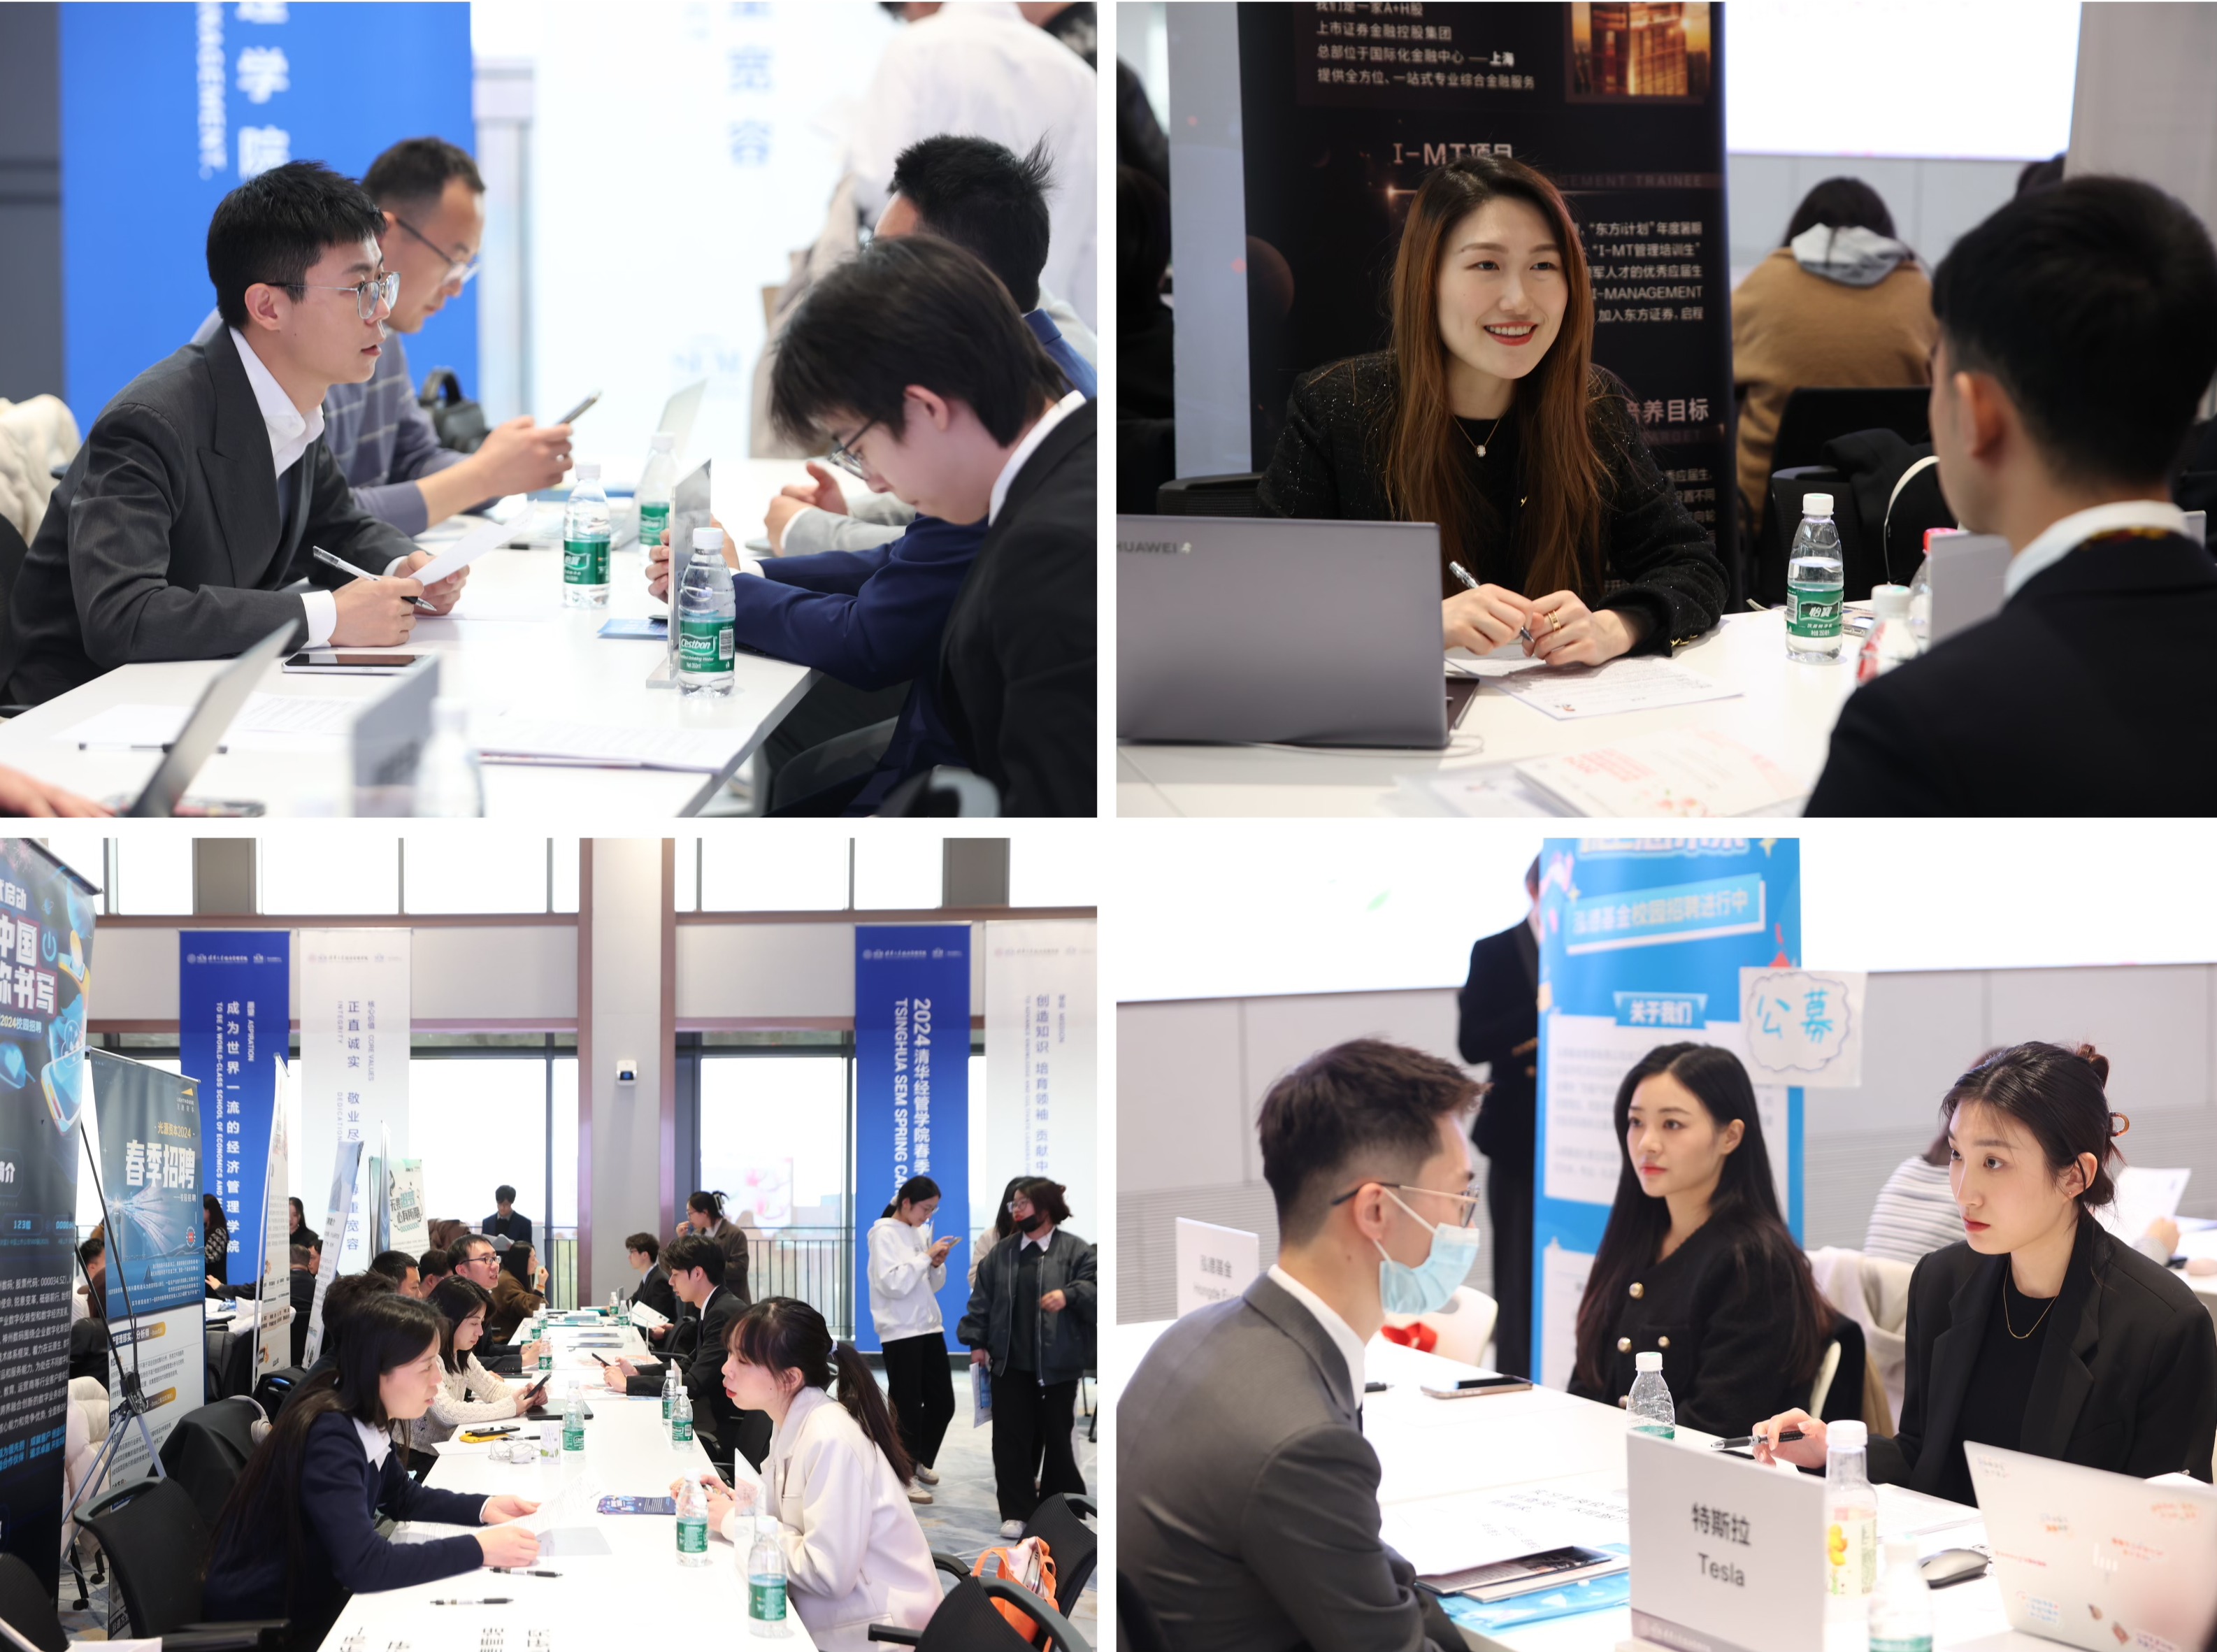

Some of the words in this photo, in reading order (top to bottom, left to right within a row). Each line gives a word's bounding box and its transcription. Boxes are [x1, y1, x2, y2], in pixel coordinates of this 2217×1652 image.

[1316, 21, 1453, 41] 上市证券金融控股集团
[1317, 45, 1465, 65] 总部位于国际化金融中心
[1318, 68, 1535, 90] 提供全方位、一站式专业综合金融服务
[1636, 175, 1702, 186] TRAINEE
[681, 638, 711, 649] Cestbon
[216, 1002, 224, 1012] TO
[216, 1014, 224, 1023] BE
[914, 998, 931, 1046] 2024
[1036, 994, 1049, 1054] 创造知识
[1629, 1000, 1693, 1026] 关于我们
[1758, 990, 1833, 1044] 公募
[347, 1001, 359, 1068] 正直诚实
[894, 998, 908, 1072] TSINGHUA
[894, 1075, 908, 1105] SEM
[1036, 1062, 1049, 1121] 培育领袖
[216, 1121, 224, 1131] OF
[226, 1001, 240, 1253] 成为世界一流的经济管理学院
[347, 1092, 359, 1141] 敬业尽
[914, 1048, 931, 1176] 清华经管学院春季
[894, 1108, 908, 1161] SPRING
[1035, 1130, 1049, 1172] 贡献中
[125, 1140, 195, 1189] 春季招聘
[1691, 1502, 1751, 1546] 特斯拉
[1698, 1553, 1746, 1588] Tesla
